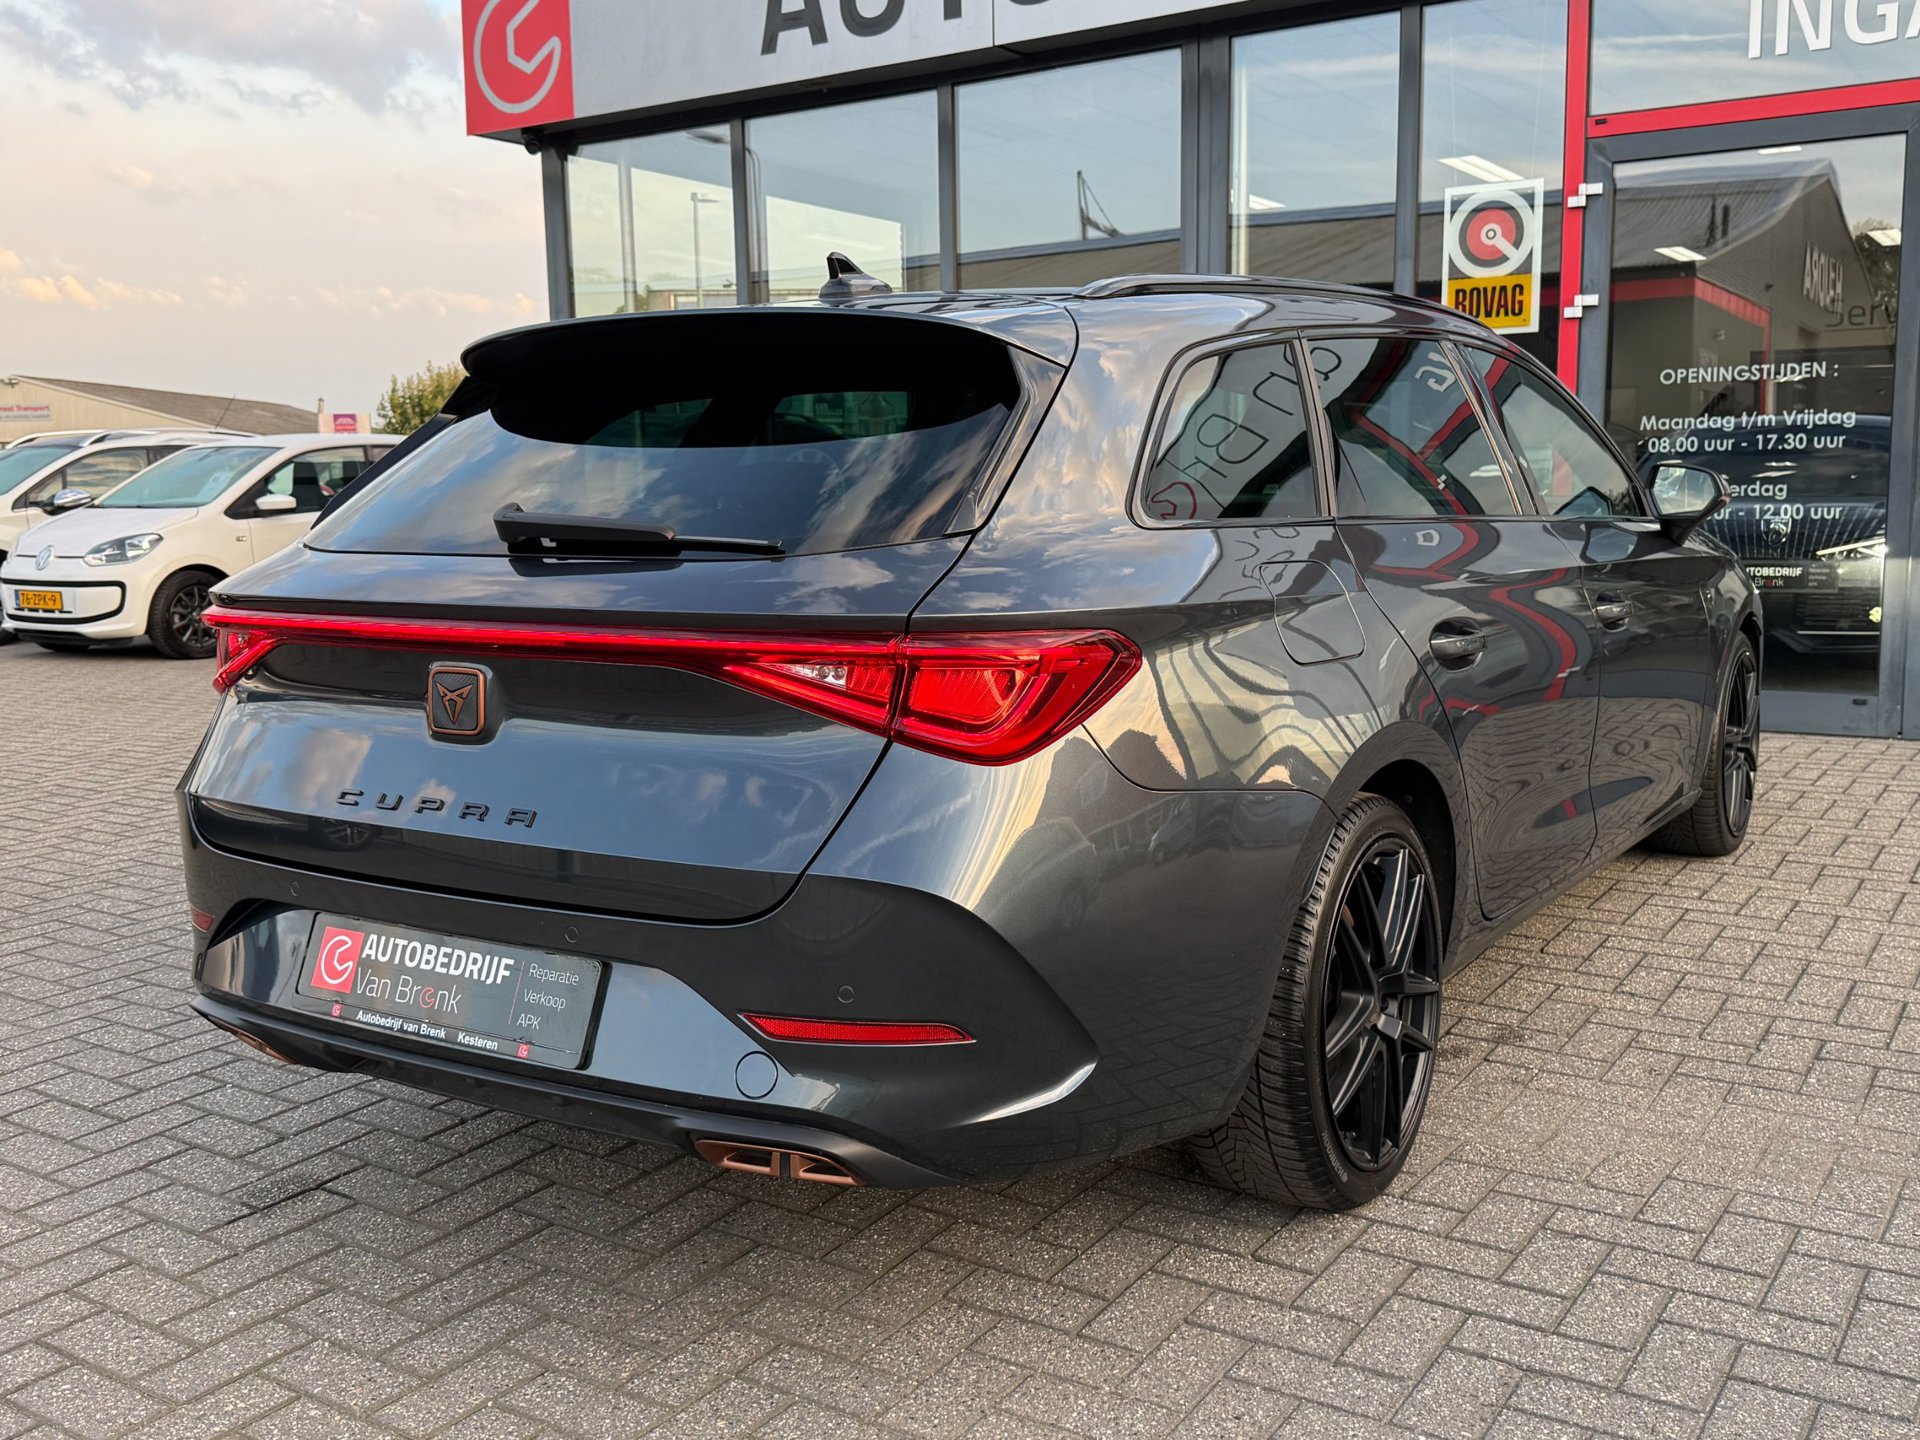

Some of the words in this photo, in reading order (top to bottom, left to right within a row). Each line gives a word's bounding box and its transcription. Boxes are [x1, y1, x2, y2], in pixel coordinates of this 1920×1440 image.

[1748, 0, 1920, 59] ING
[1454, 283, 1524, 318] BOVAG
[1660, 361, 1826, 385] OPENINGSTIJDEN
[1640, 413, 1735, 431] Maandag
[1741, 411, 1775, 429] t/m
[1783, 408, 1856, 429] Vrijdag
[1704, 439, 1735, 451] uur
[1756, 434, 1807, 450] 17.30
[1813, 434, 1846, 448] uur
[1729, 480, 1788, 500] erdag
[1753, 504, 1804, 519] 12.00
[1810, 507, 1842, 519] uur
[1746, 567, 1803, 577] TOBEDRIJF
[336, 787, 537, 828] CUPRA
[362, 933, 514, 985] AUTOBEDRIJF
[528, 963, 579, 986] Reparatie
[356, 966, 391, 1000] Van
[395, 975, 462, 1014] Brenk
[524, 988, 566, 1012] Verkoop
[356, 1010, 403, 1031] Autobedrijf
[403, 1022, 419, 1034] van
[419, 1023, 447, 1039] Brenk
[457, 1031, 498, 1051] Kesteren
[516, 1013, 541, 1030] APK
